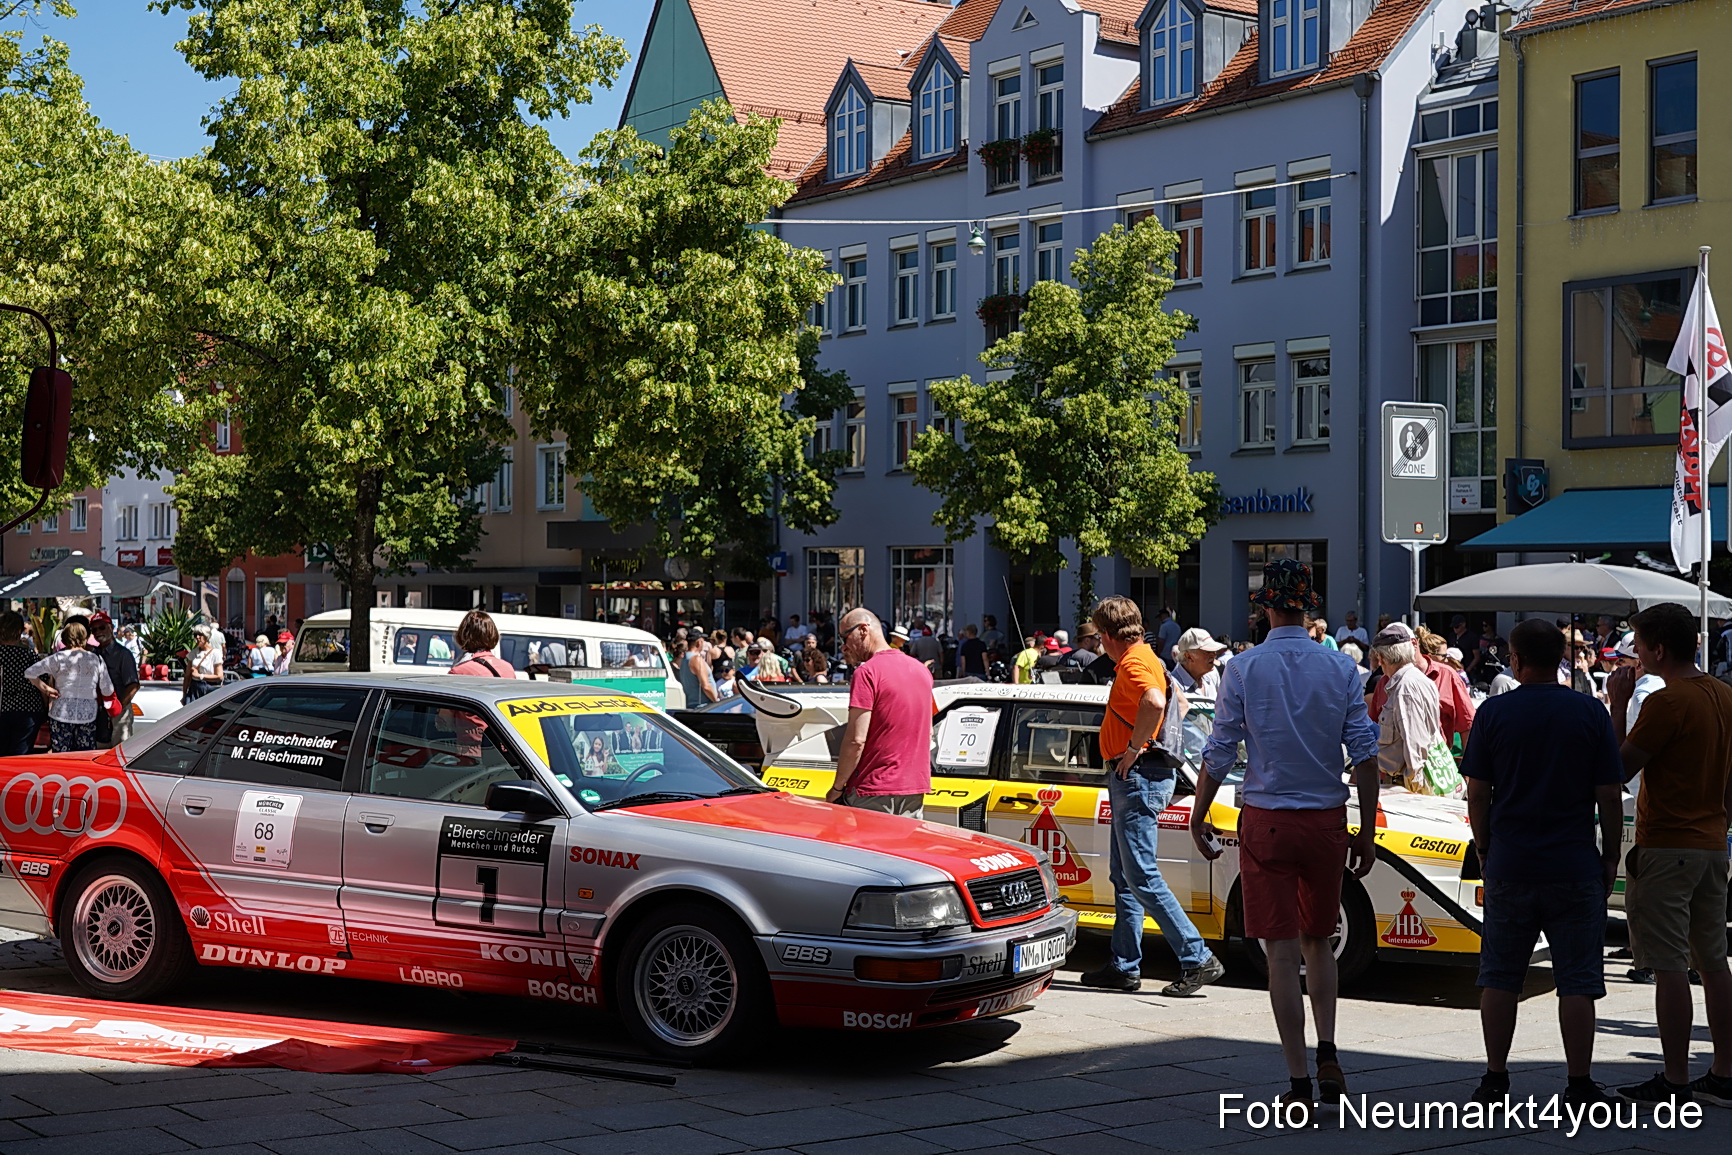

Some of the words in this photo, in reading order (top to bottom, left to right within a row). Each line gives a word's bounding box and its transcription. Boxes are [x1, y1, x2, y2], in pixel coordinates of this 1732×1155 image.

[1403, 463, 1426, 474] ZONE
[1219, 487, 1314, 514] senbank
[507, 700, 564, 717] Audi
[238, 730, 250, 742] G.
[253, 731, 337, 749] Bierschneider
[959, 734, 976, 747] 70
[231, 747, 244, 759] M.
[248, 748, 324, 766] Fleischmann
[1157, 812, 1186, 822] NREMO
[254, 822, 274, 840] 68
[448, 823, 544, 845] Bierschneider
[450, 840, 491, 850] Menschen
[493, 843, 509, 852] und
[511, 844, 538, 855] Autos.
[1024, 827, 1067, 866] HB
[1409, 835, 1462, 856] Castrol
[569, 846, 641, 870] SONAX
[969, 852, 1023, 872] SONAX
[20, 861, 50, 876] BBS
[475, 865, 499, 925] 1
[215, 912, 267, 936] Shell
[1395, 914, 1423, 936] HB
[347, 931, 389, 943] TECHNIK
[1387, 935, 1430, 945] international
[200, 944, 347, 974] DUNLOP
[479, 943, 567, 968] KONI
[573, 957, 593, 966] KONI
[783, 945, 830, 964] BBS
[967, 951, 1006, 976] Shell
[1021, 945, 1035, 967] NM
[1040, 942, 1047, 963] V
[399, 965, 464, 988] LÖBRO
[527, 979, 598, 1004] BOSCH
[971, 984, 1041, 1017] DUNLOP
[843, 1010, 913, 1029] BOSCH
